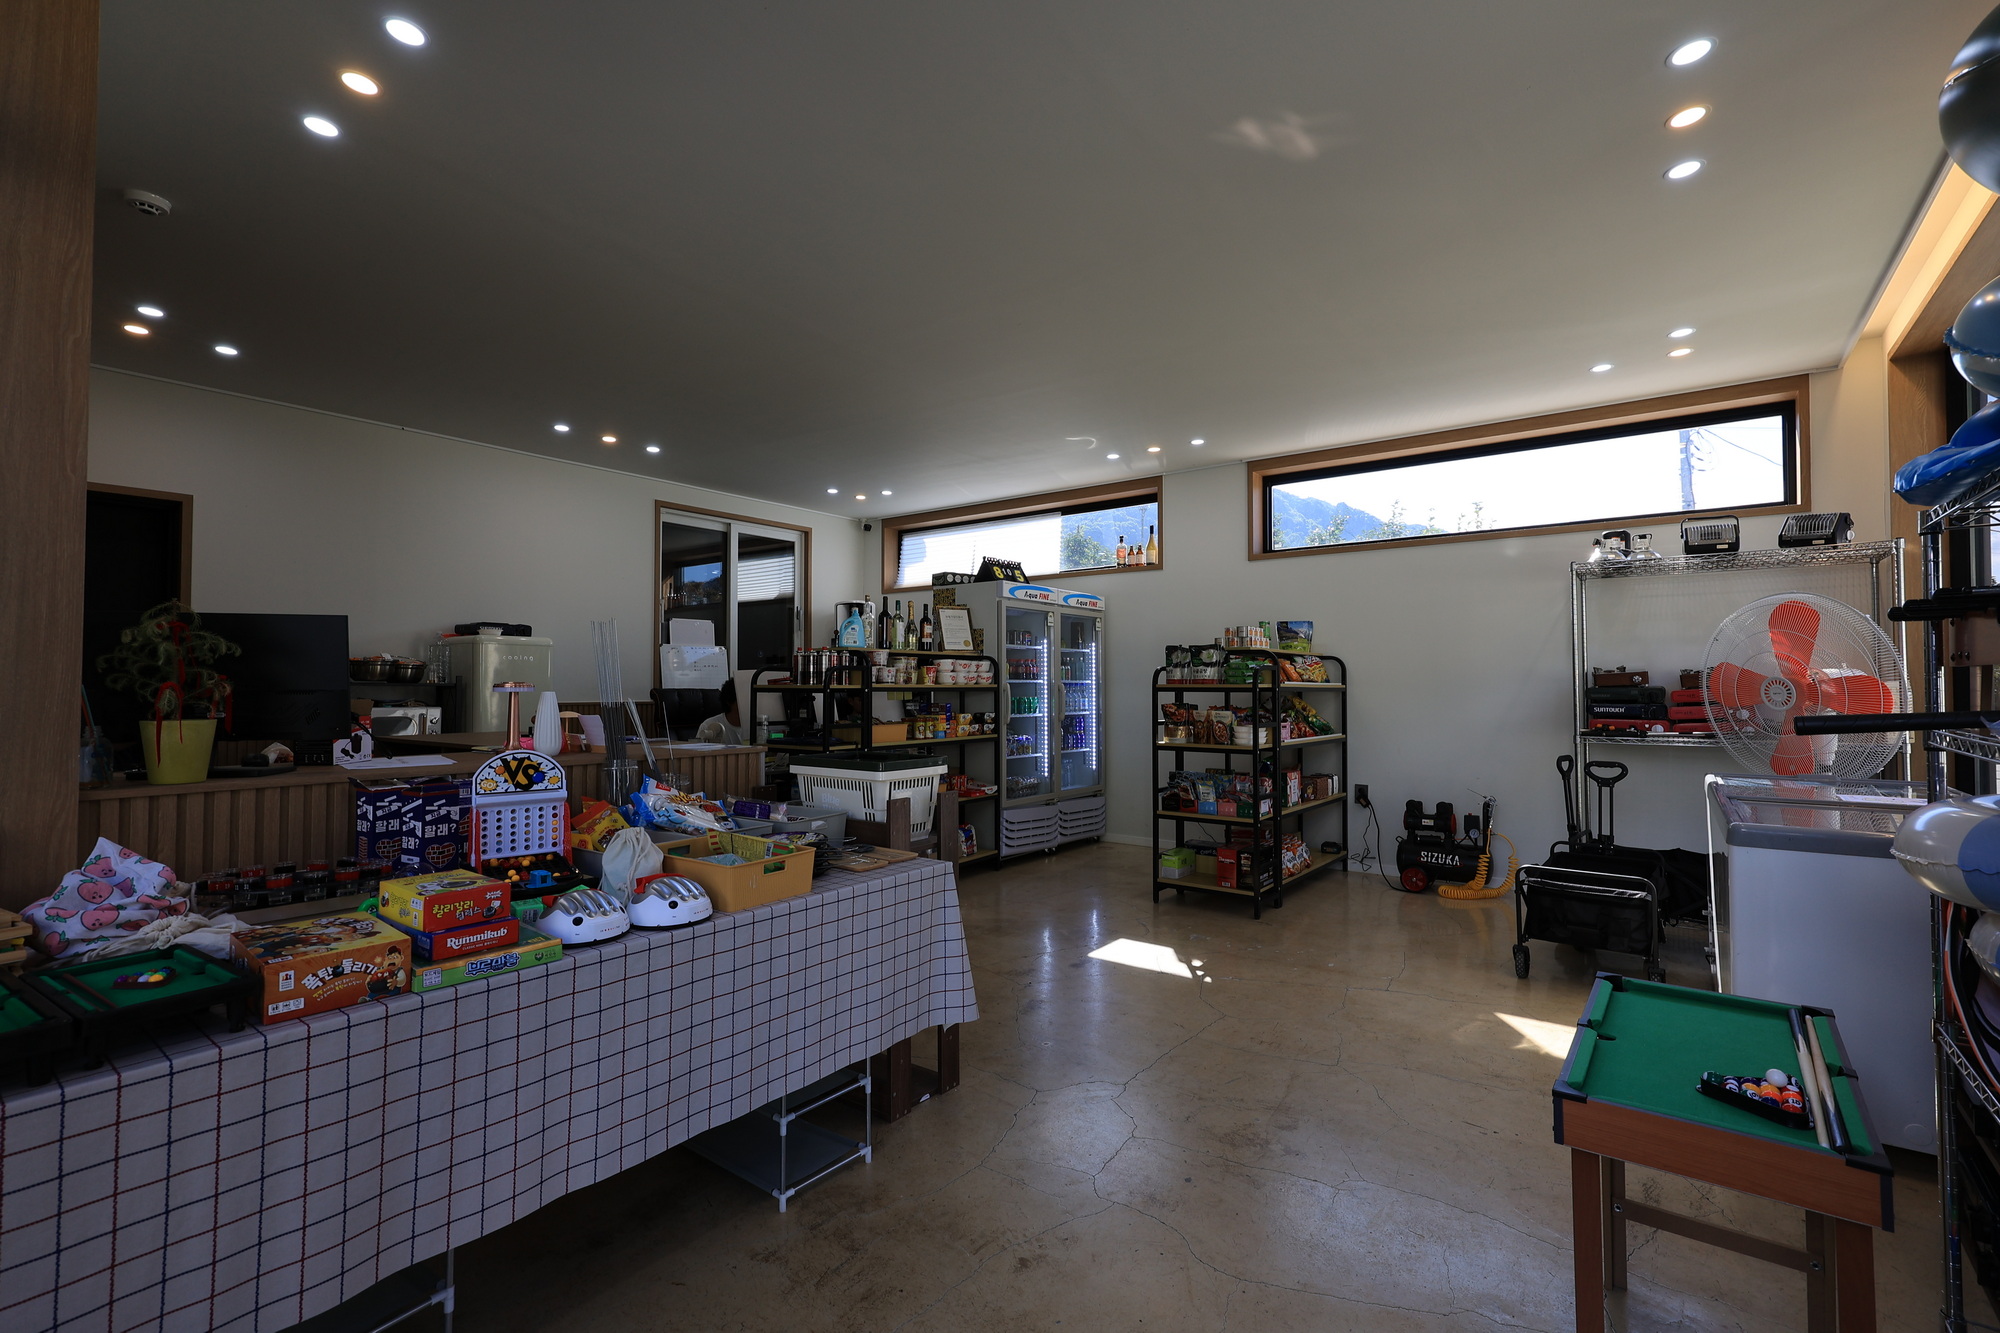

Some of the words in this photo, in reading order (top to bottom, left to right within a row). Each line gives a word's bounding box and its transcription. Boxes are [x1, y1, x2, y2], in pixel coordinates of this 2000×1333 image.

[993, 566, 1005, 579] 8
[1014, 570, 1025, 582] 5
[1039, 593, 1050, 601] FINE
[499, 757, 541, 791] VS
[424, 823, 457, 839] 할래?
[1420, 851, 1461, 866] SIZUKA
[432, 900, 475, 919] 할리갈리
[446, 927, 508, 950] Rummikub
[301, 966, 334, 990] 폭탄
[341, 957, 378, 975] 돌리기
